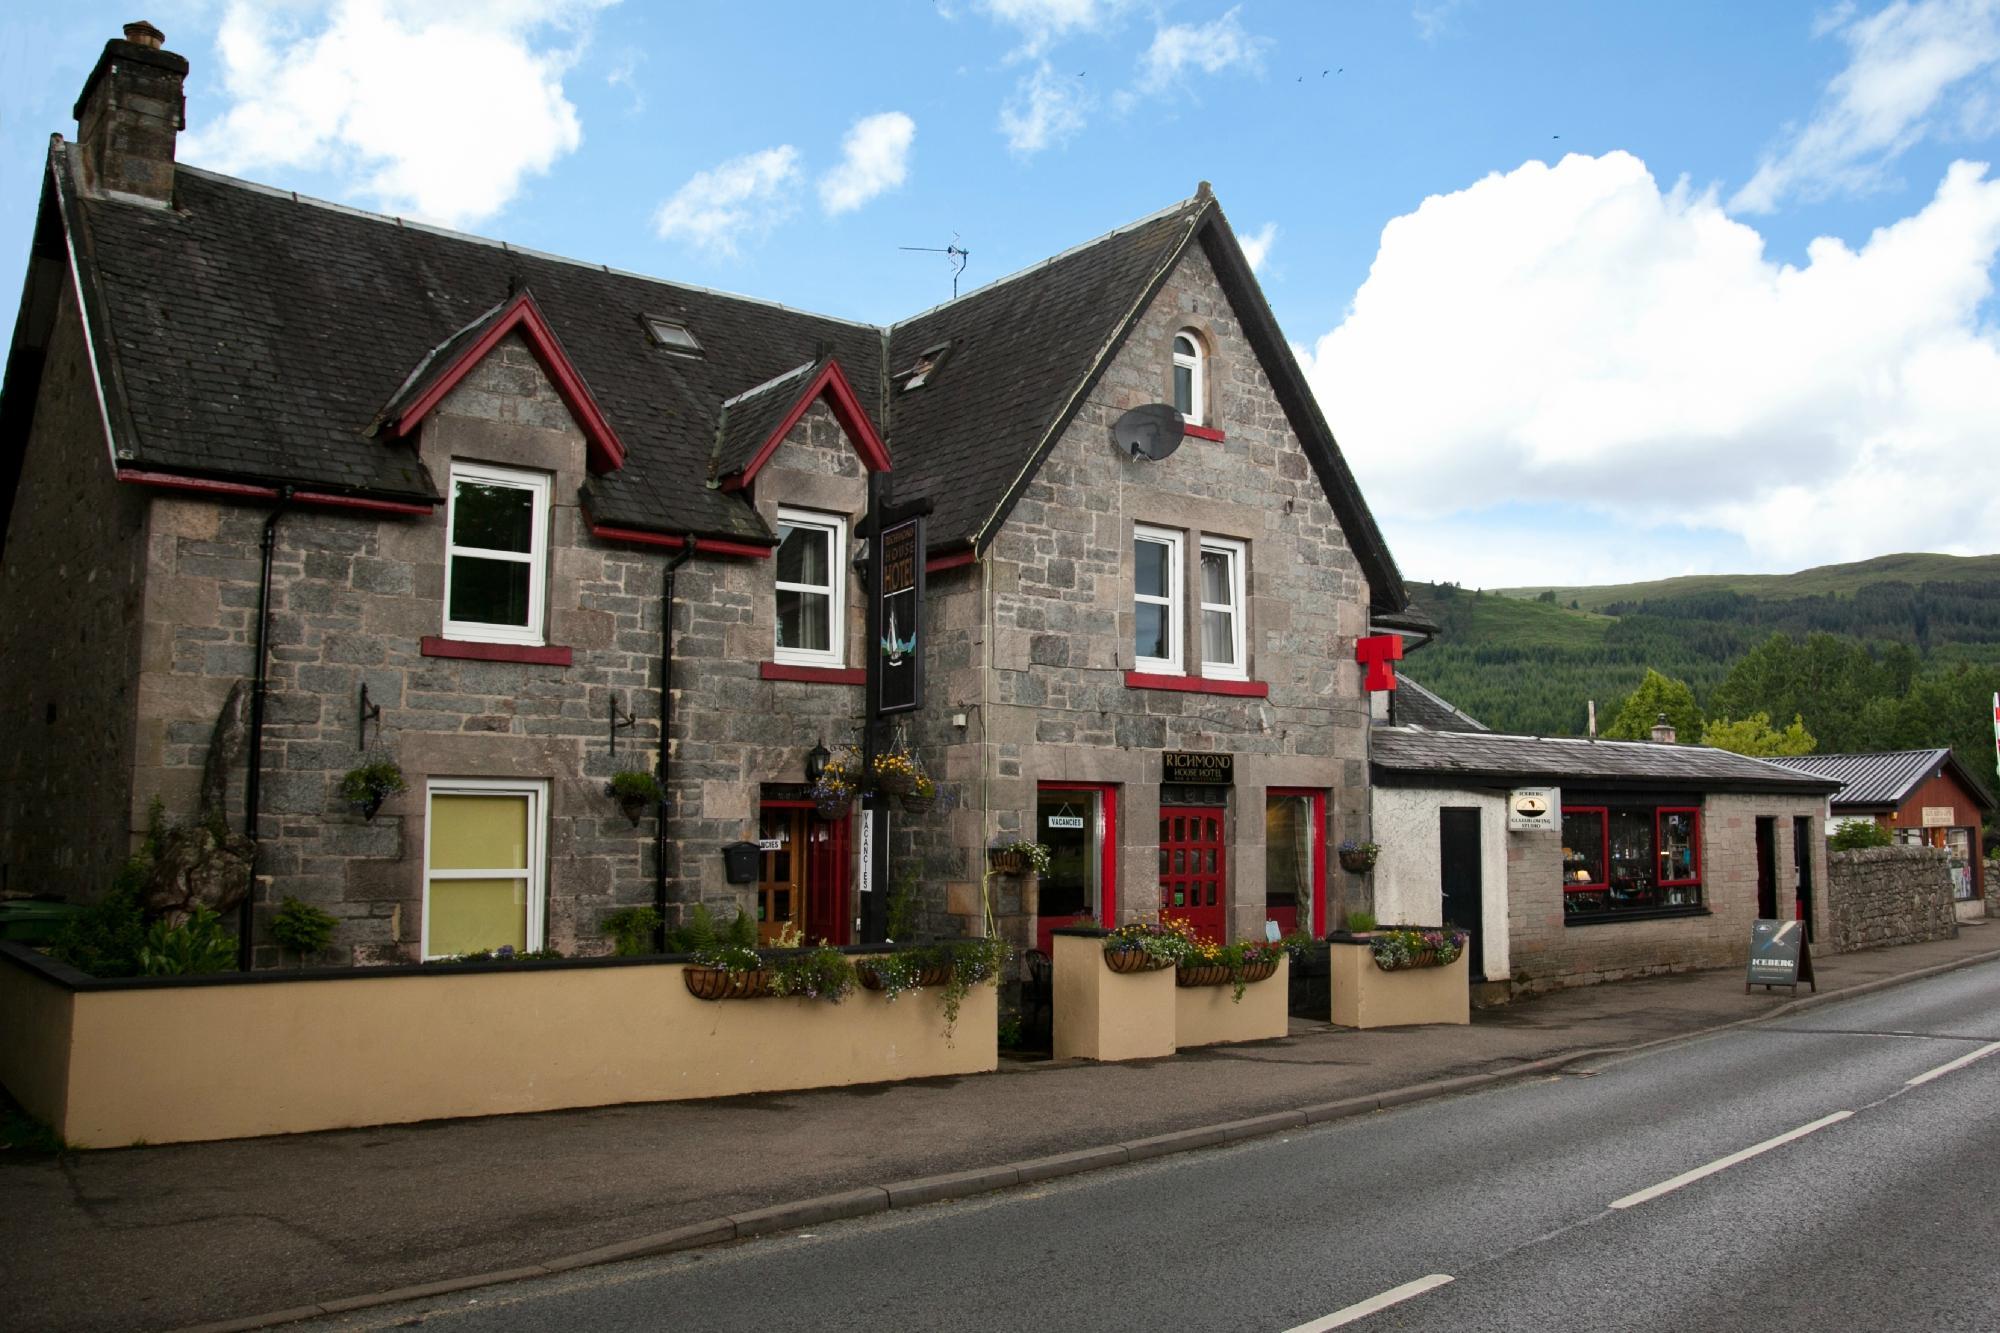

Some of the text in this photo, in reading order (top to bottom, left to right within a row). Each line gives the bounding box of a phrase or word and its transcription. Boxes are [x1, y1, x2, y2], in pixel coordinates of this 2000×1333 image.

[885, 543, 914, 561] HOUSE
[884, 559, 914, 592] HOTEL
[1166, 754, 1230, 768] RICHMOND
[1174, 768, 1222, 777] HOUSE HOTEL
[1051, 818, 1081, 827] VACANCIES
[1752, 958, 1794, 967] ICEBERG
